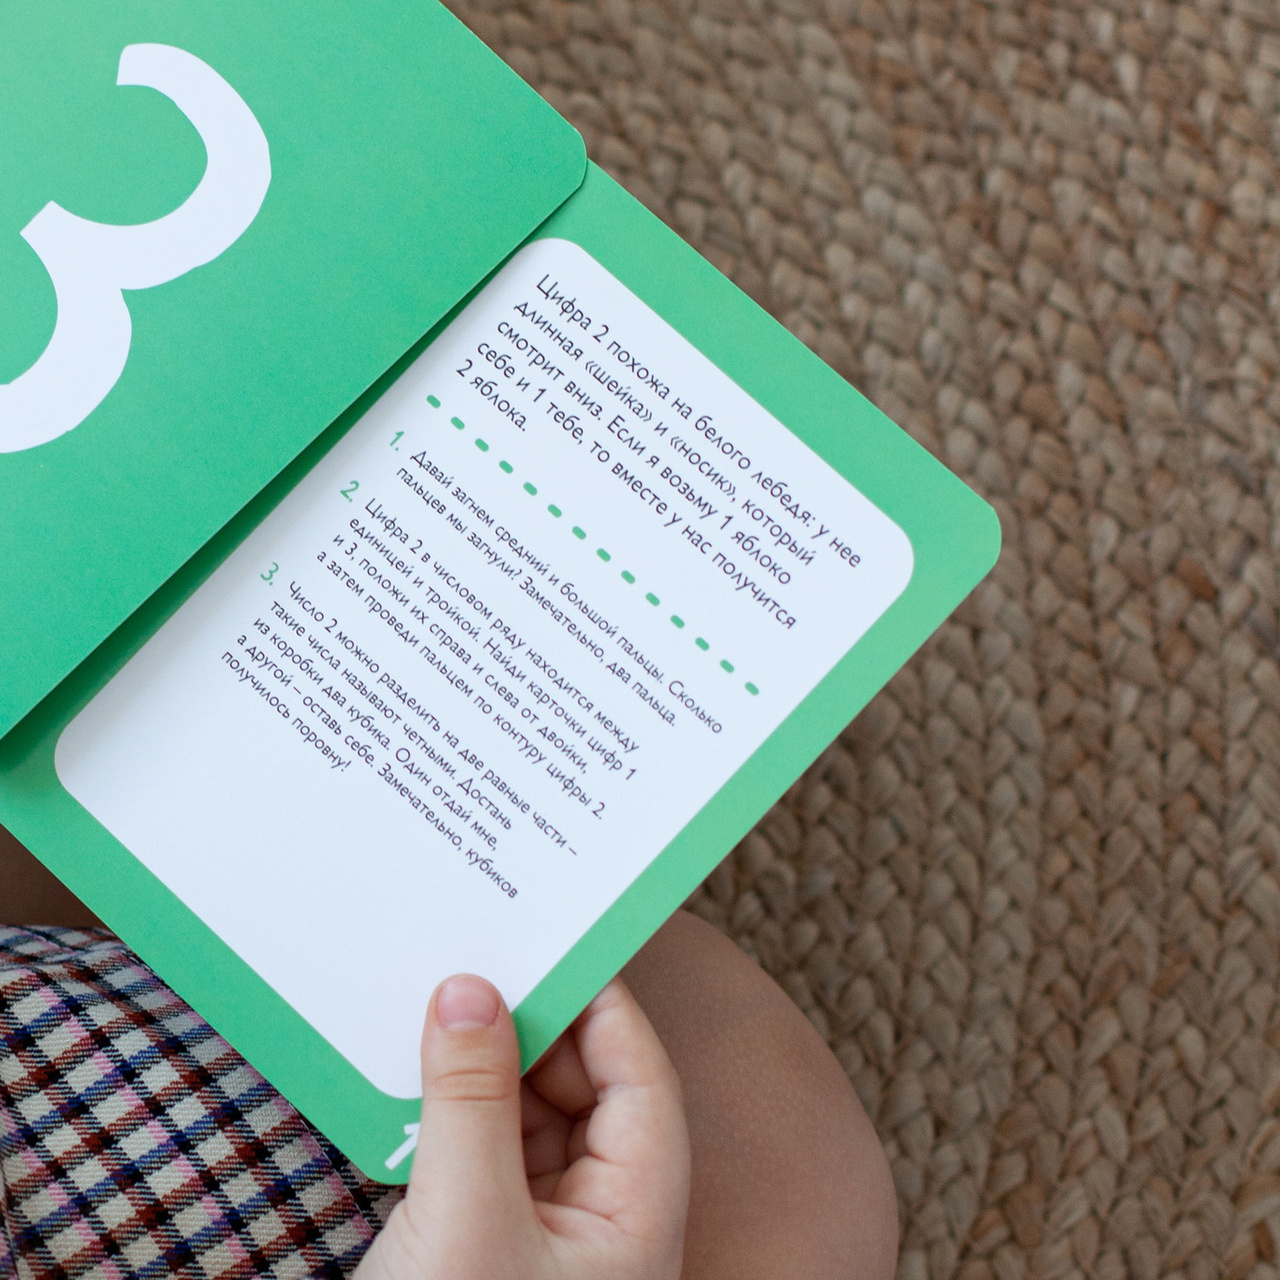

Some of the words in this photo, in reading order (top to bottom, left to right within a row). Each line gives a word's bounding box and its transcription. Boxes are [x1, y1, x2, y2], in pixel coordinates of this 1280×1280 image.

[454, 357, 474, 379] 2
[468, 375, 528, 433] яблока.
[476, 341, 517, 380] себе
[514, 375, 532, 393] и
[532, 387, 548, 404] 1
[545, 400, 585, 446] тебе,
[589, 439, 612, 464] то
[610, 461, 669, 516] вместе
[662, 511, 684, 529] у
[680, 523, 714, 556] нас
[710, 551, 798, 630] получится
[496, 320, 567, 382] смотрит
[562, 379, 604, 422] вниз.
[605, 413, 648, 457] Если
[644, 454, 662, 470] я
[658, 465, 720, 521] возьму
[719, 514, 735, 531] 1
[730, 530, 792, 586] яблоко
[512, 300, 585, 363] длинная
[652, 420, 670, 438] и
[740, 498, 817, 567] который
[535, 272, 593, 332] Цифра
[591, 323, 611, 345] 2
[605, 339, 671, 401] похожа
[670, 396, 694, 421] на
[693, 414, 752, 471] белого
[749, 470, 817, 528] лебедя:
[810, 523, 831, 541] у
[828, 535, 862, 569] нее
[220, 650, 291, 720] получилось
[290, 716, 353, 773] поровну!
[259, 561, 281, 587] 3.
[288, 579, 326, 623] Число
[323, 616, 339, 635] 2
[333, 629, 381, 675] можно
[375, 671, 442, 733] разделить
[441, 729, 461, 750] на
[456, 748, 485, 772] две
[479, 768, 532, 815] равные
[531, 810, 568, 849] части
[269, 599, 307, 638] такие
[306, 633, 342, 672] числа
[339, 667, 403, 725] называют
[402, 722, 458, 781] четными.
[455, 776, 513, 831] Достань
[315, 550, 328, 564] а
[325, 559, 366, 598] затем
[363, 593, 421, 649] проведи
[418, 644, 475, 699] пальцем
[472, 694, 494, 716] по
[492, 712, 548, 766] контуру
[545, 761, 593, 807] цифры
[590, 800, 607, 821] 2.
[331, 533, 346, 548] и
[343, 540, 359, 562] 3,
[357, 557, 412, 608] положи
[408, 604, 431, 626] их
[428, 622, 473, 666] справа
[471, 661, 486, 676] и
[483, 673, 521, 710] слева
[519, 706, 541, 725] от
[535, 725, 589, 775] двойки,
[338, 479, 361, 504] 2.
[363, 496, 411, 546] Цифра
[408, 537, 424, 556] 2
[419, 551, 432, 564] в
[432, 560, 494, 622] числовом
[488, 617, 528, 651] ряду
[524, 647, 595, 714] находится
[592, 710, 640, 755] между
[348, 517, 416, 579] единицей
[411, 575, 426, 590] и
[424, 585, 483, 644] тройкой.
[481, 636, 528, 684] Найди
[525, 680, 588, 739] карточки
[586, 735, 624, 772] цифр
[624, 767, 638, 781] 1
[388, 429, 406, 453] 1.
[408, 449, 455, 490] Давай
[450, 485, 496, 529] загнем
[493, 524, 551, 577] средний
[547, 573, 561, 587] и
[559, 581, 620, 639] большой
[615, 635, 665, 685] пальцы.
[667, 679, 724, 735] Сколько
[395, 466, 448, 516] пальцев
[444, 512, 469, 536] мы
[465, 530, 524, 582] загнули?
[517, 575, 606, 664] Замечательно,
[604, 661, 633, 685] два
[630, 680, 677, 728] пальца.
[235, 633, 248, 647] а
[243, 644, 295, 688] другой
[301, 694, 343, 737] оставь
[343, 733, 376, 769] себе.
[376, 761, 464, 852] Замечательно,
[464, 847, 519, 900] кубиков
[252, 616, 272, 637] из
[268, 632, 325, 687] коробки
[320, 684, 348, 709] два
[345, 704, 392, 752] кубика.
[394, 746, 433, 787] Один
[431, 784, 474, 824] отдай
[469, 820, 498, 852] мне,
